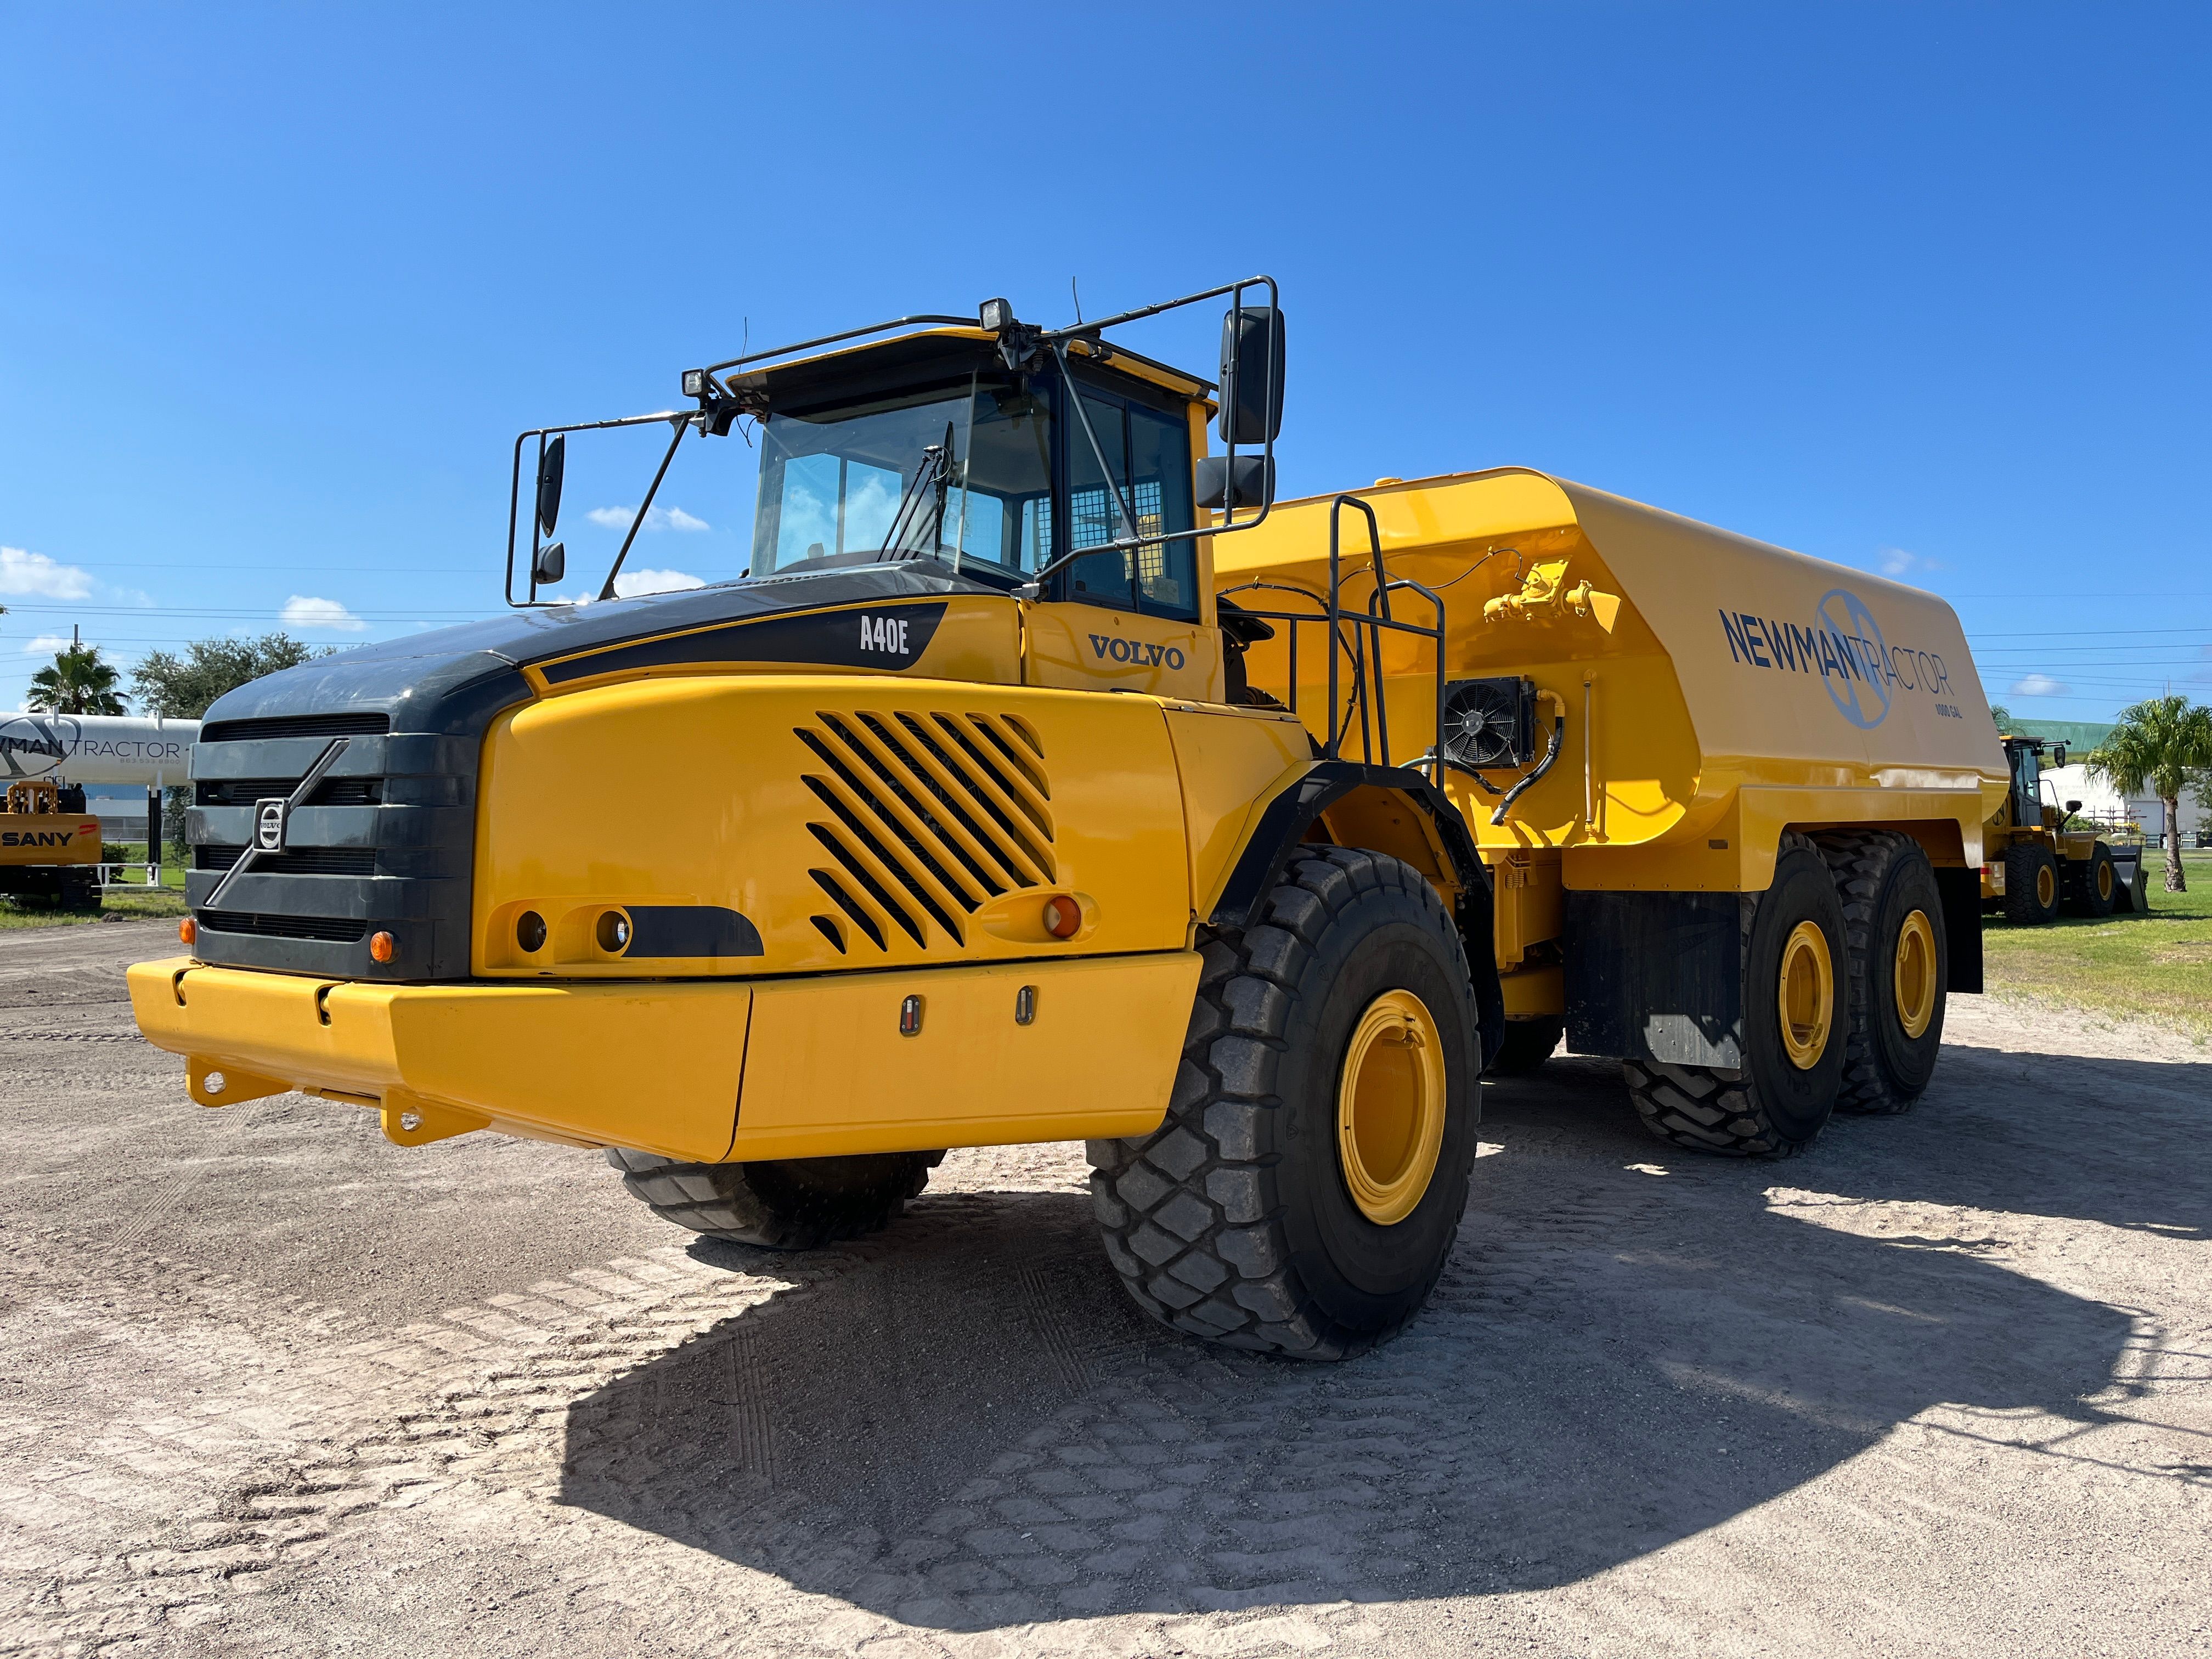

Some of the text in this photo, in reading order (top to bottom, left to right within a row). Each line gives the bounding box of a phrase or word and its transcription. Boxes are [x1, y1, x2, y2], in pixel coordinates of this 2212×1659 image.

[860, 615, 909, 654] A40E
[1088, 634, 1185, 670] VOLVO
[1949, 704, 1963, 719] GAL
[2, 832, 74, 847] SANY
